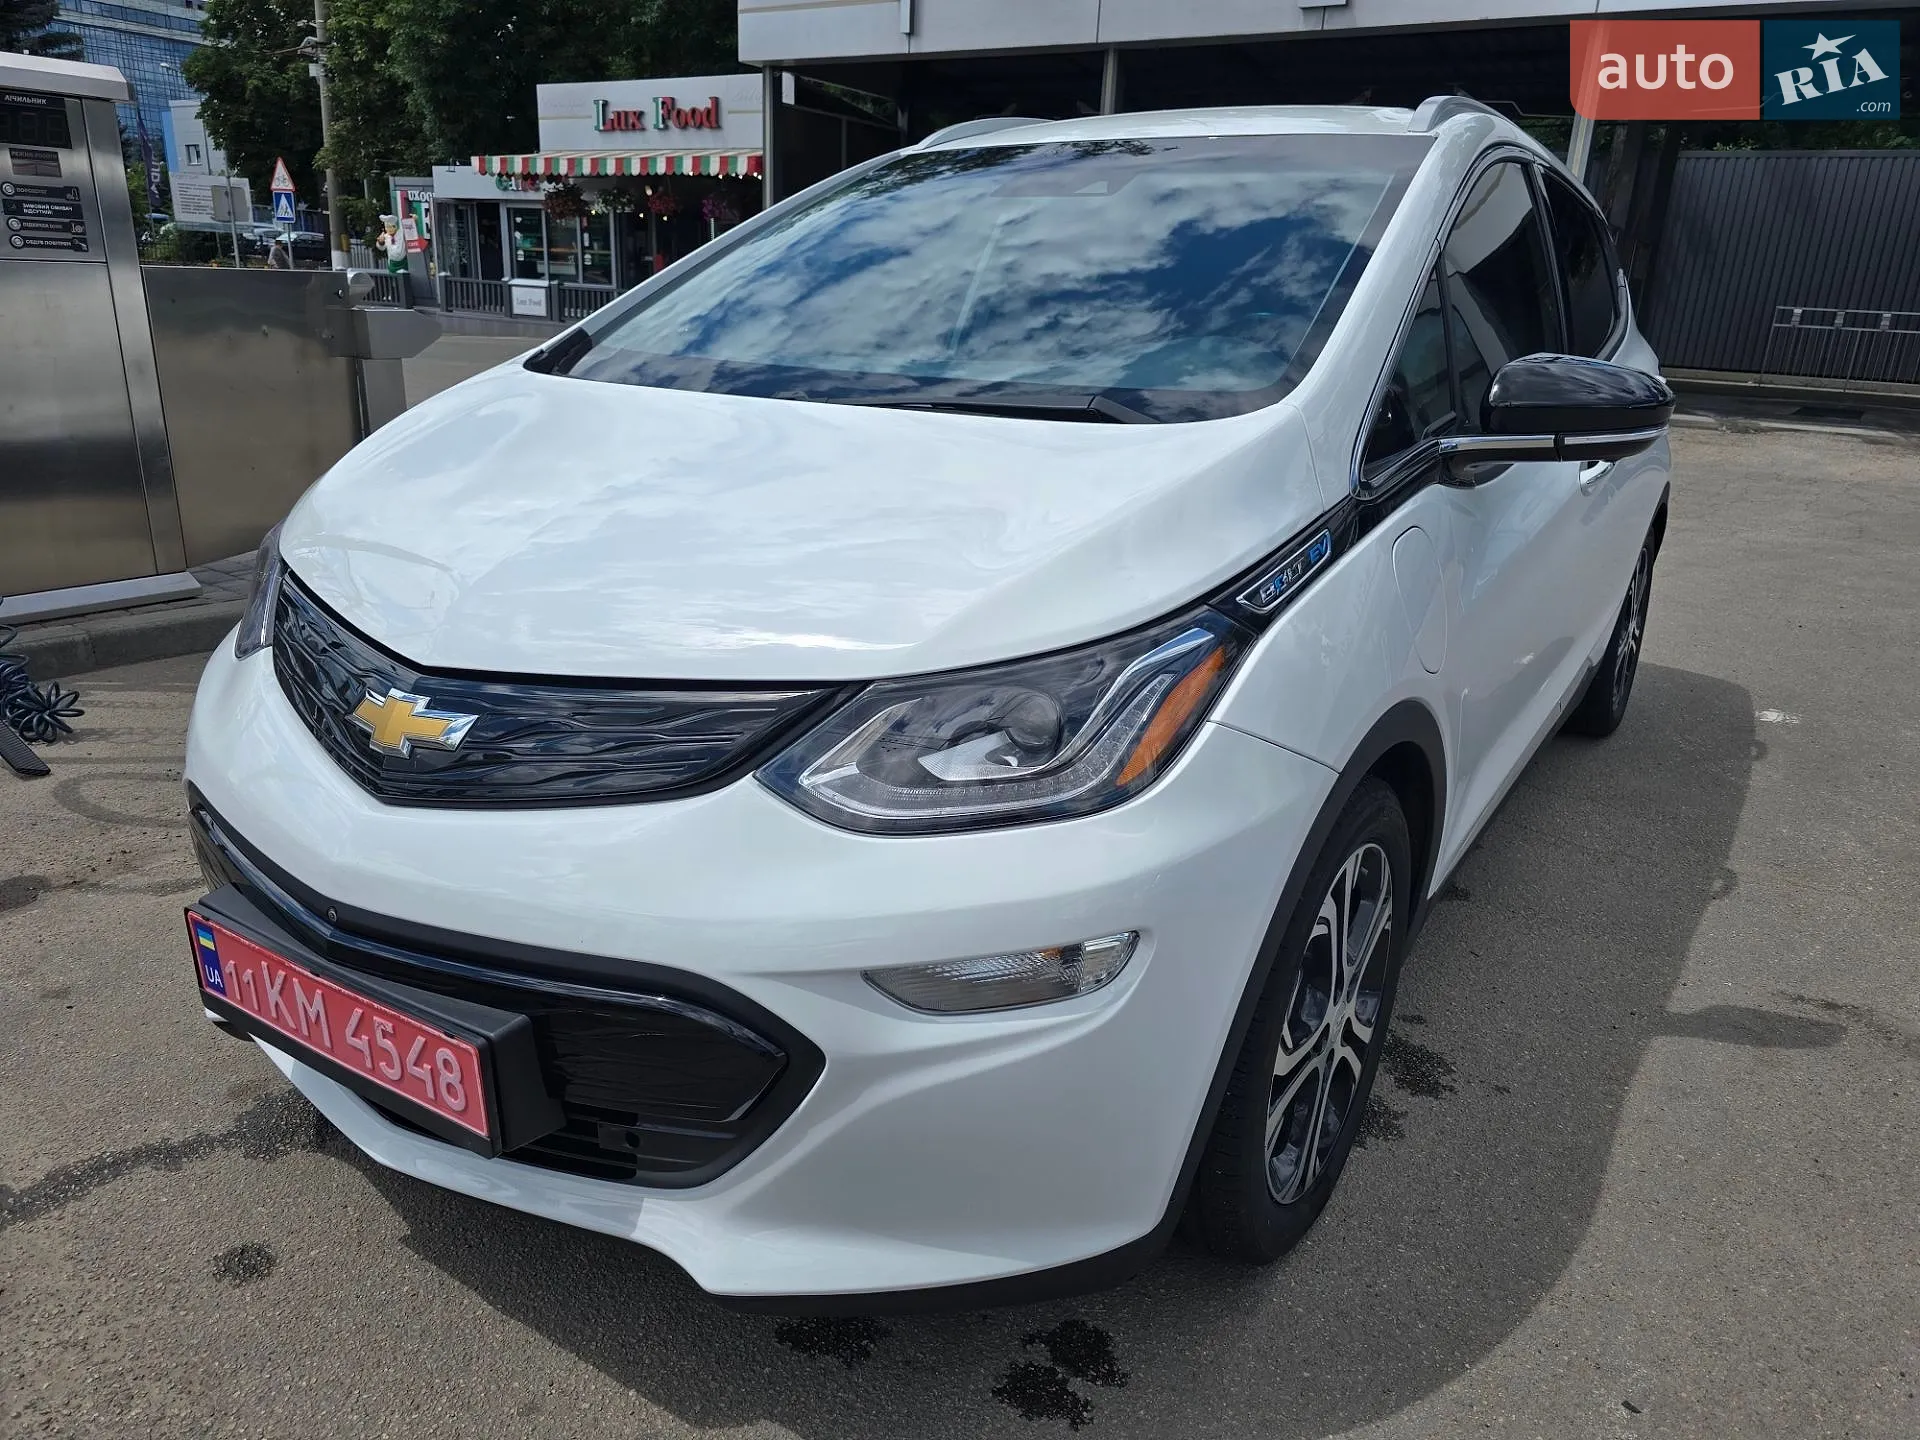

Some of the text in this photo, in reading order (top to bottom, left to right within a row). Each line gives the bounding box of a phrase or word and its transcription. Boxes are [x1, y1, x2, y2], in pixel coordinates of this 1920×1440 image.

[593, 99, 646, 132] Lux
[652, 96, 722, 130] Food
[204, 964, 223, 989] UA
[344, 1006, 466, 1113] 4548
